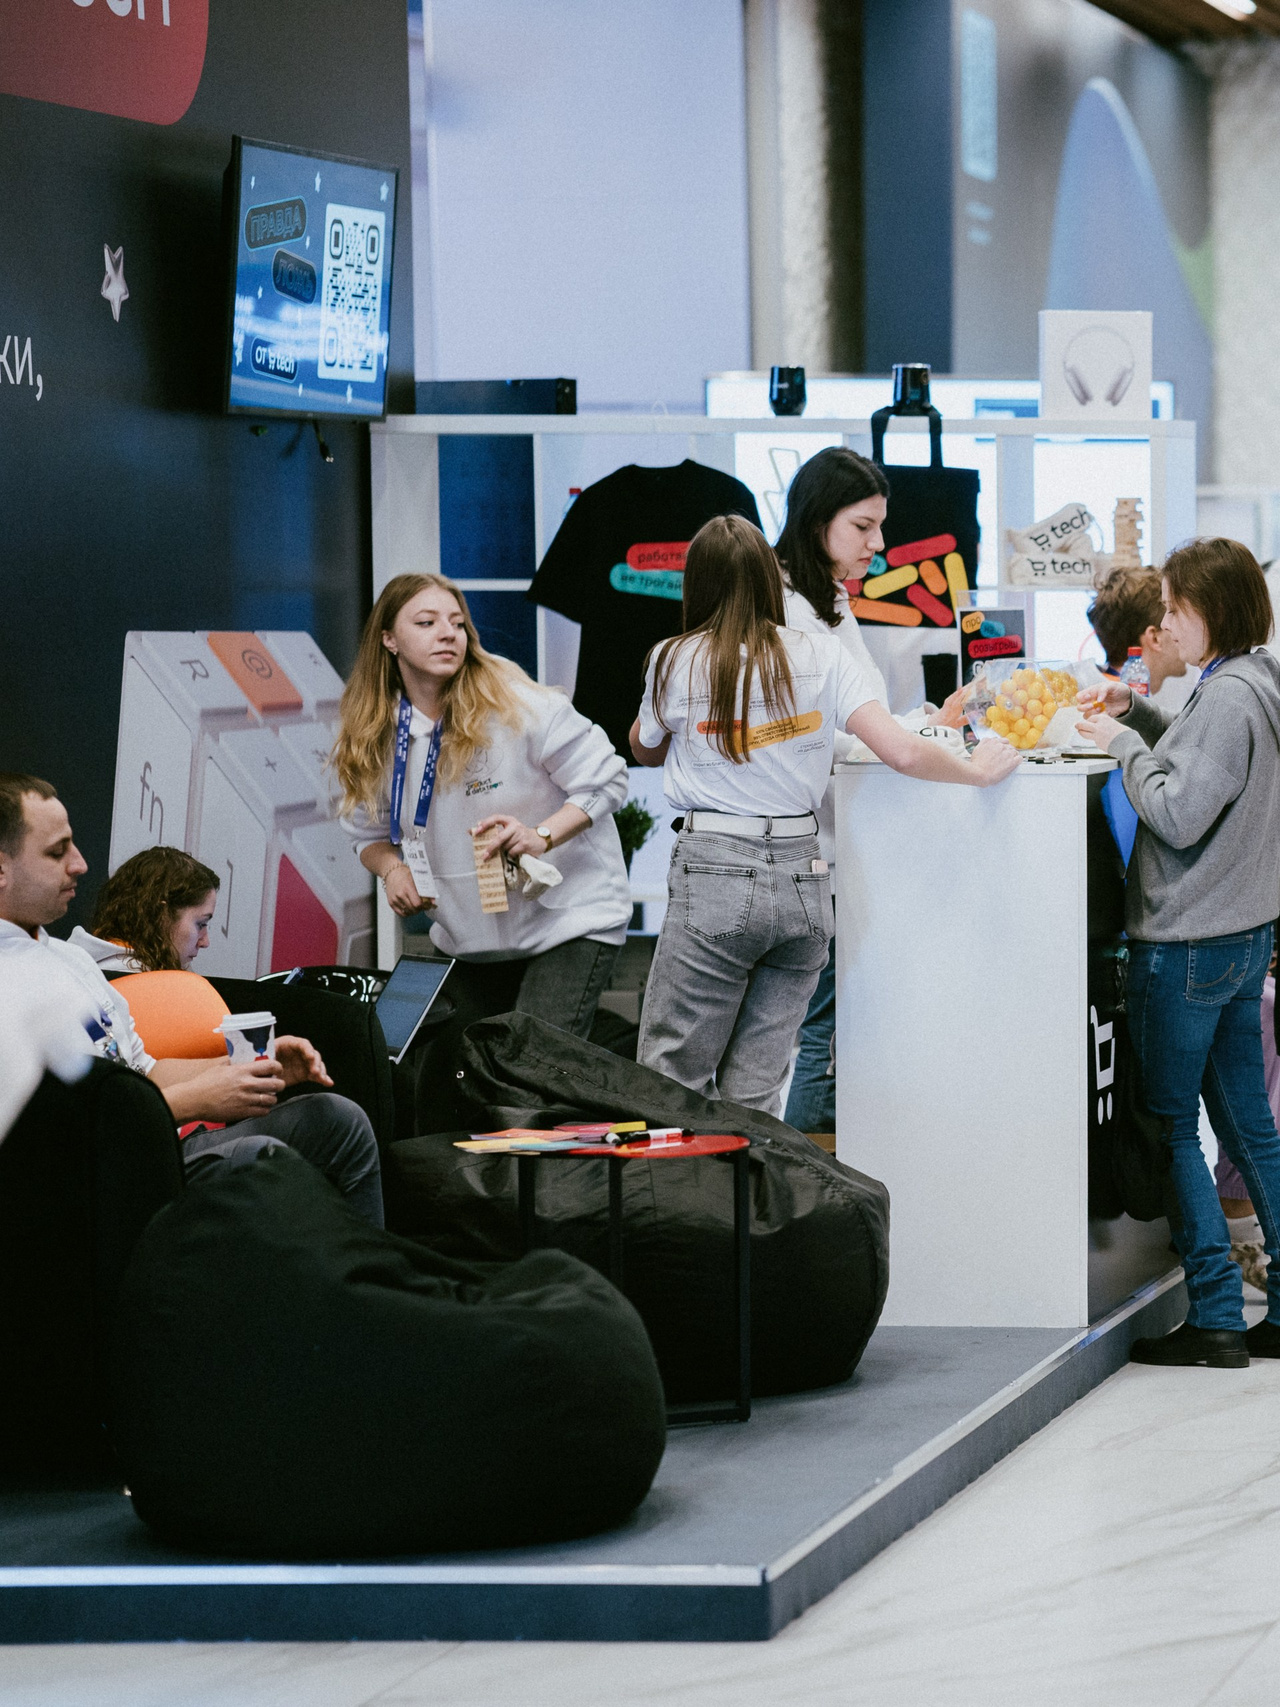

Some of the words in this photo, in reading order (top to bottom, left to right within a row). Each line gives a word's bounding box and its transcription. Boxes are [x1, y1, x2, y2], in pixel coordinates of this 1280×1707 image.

[250, 206, 302, 242] ПРАВДА
[275, 258, 314, 299] ЛОЖЬ
[1051, 509, 1089, 539] tech
[1051, 558, 1092, 575] tech
[965, 616, 981, 630] про
[973, 640, 1018, 656] розыгрыш
[180, 658, 209, 681] R
